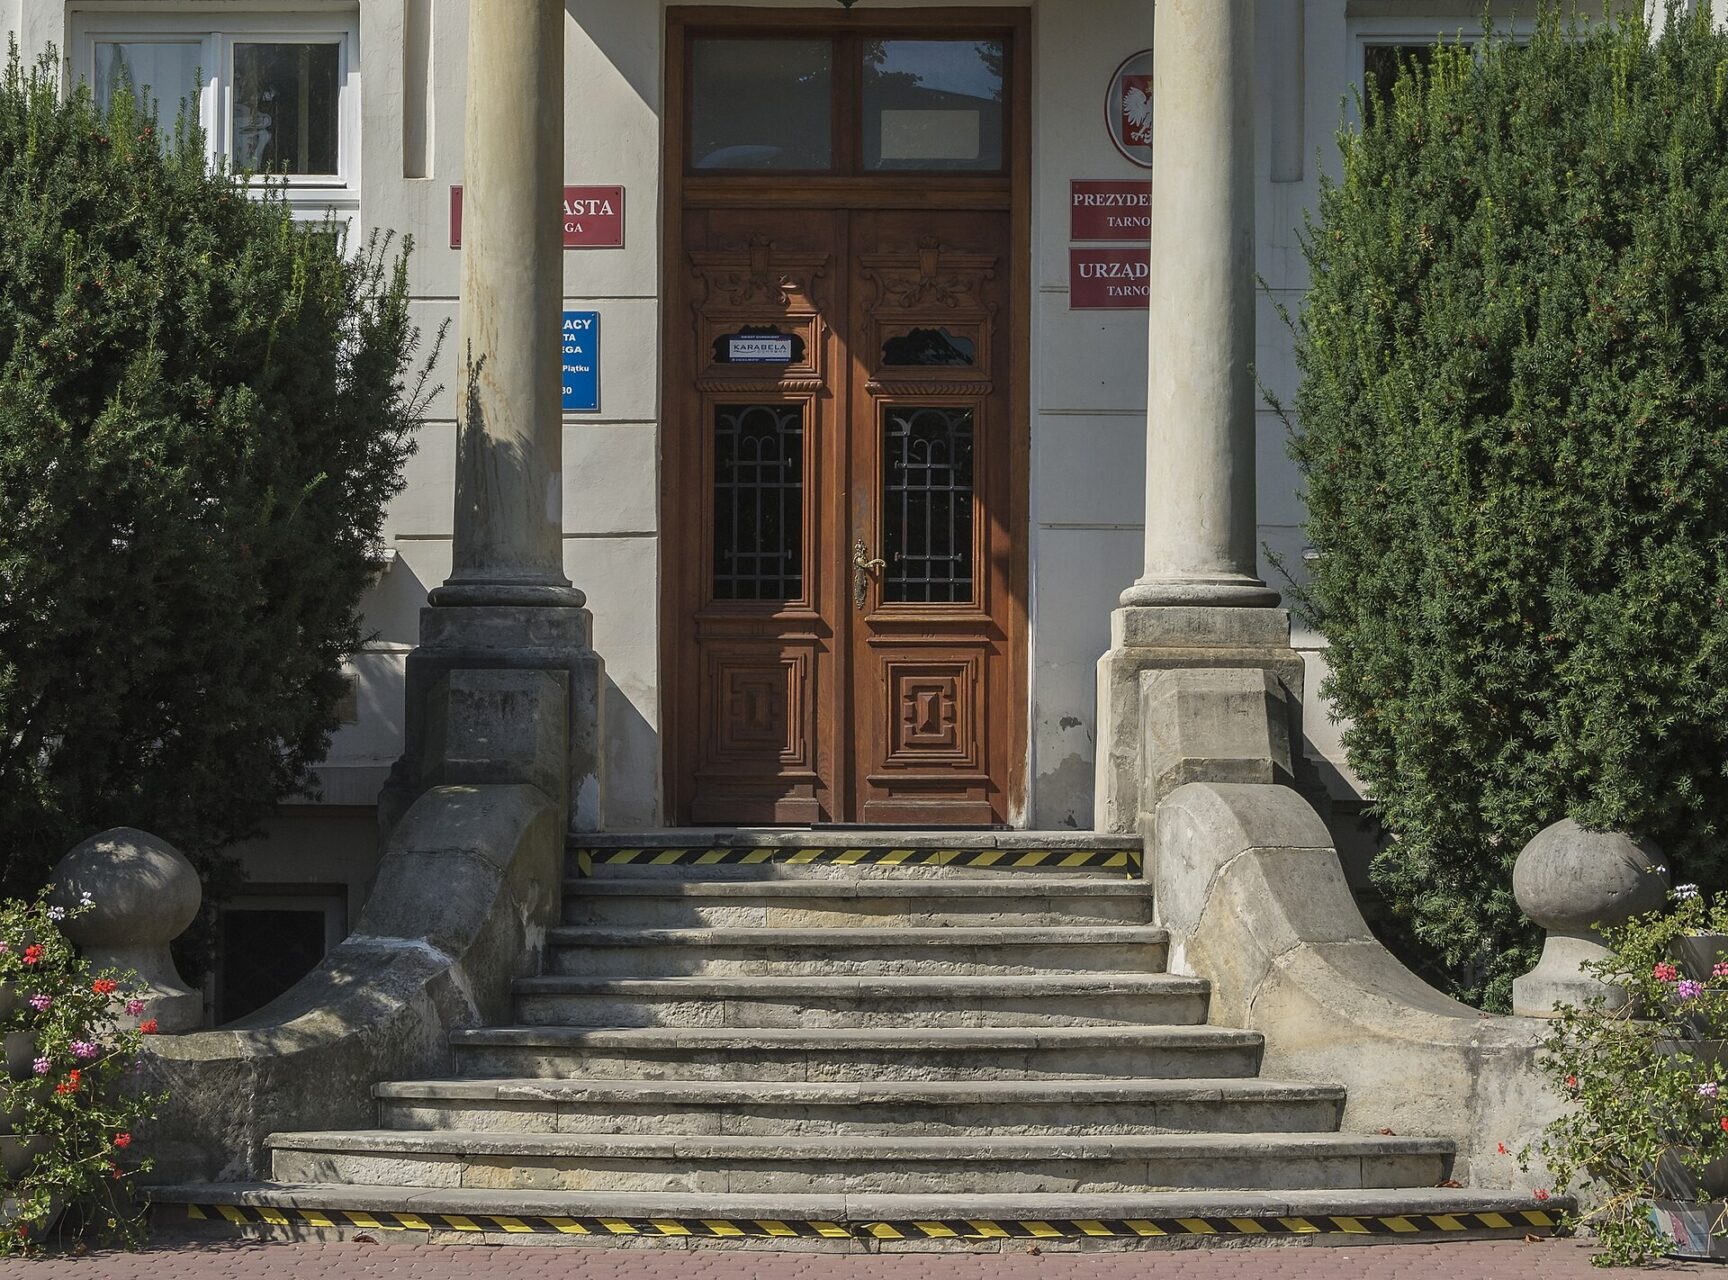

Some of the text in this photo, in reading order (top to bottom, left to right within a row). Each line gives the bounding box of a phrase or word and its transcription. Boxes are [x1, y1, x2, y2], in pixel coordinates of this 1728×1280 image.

[1078, 262, 1149, 280] URZĄD
[563, 319, 592, 330] ACY
[562, 364, 590, 373] Piątku
